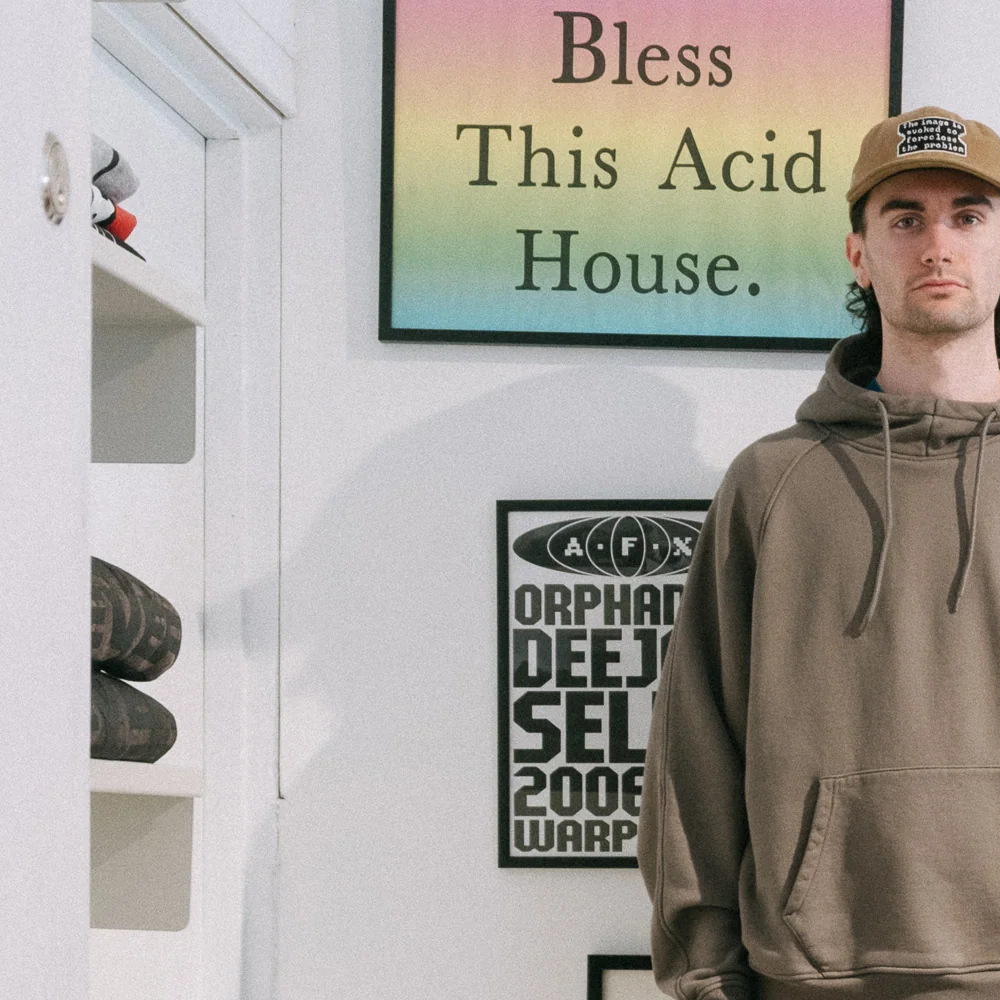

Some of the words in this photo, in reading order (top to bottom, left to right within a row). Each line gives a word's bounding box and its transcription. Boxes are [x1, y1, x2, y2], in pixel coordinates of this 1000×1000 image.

[552, 10, 734, 88] Bless
[903, 121, 919, 129] The
[922, 118, 949, 127] image
[953, 121, 962, 130] is
[907, 126, 941, 135] evoked
[907, 133, 957, 144] foreclose
[456, 124, 618, 190] This
[658, 127, 826, 194] Acid
[902, 144, 918, 153] the
[515, 229, 761, 297] House.
[513, 628, 672, 688] DEEJ
[513, 691, 656, 763] SEL
[514, 820, 638, 852] WARP
